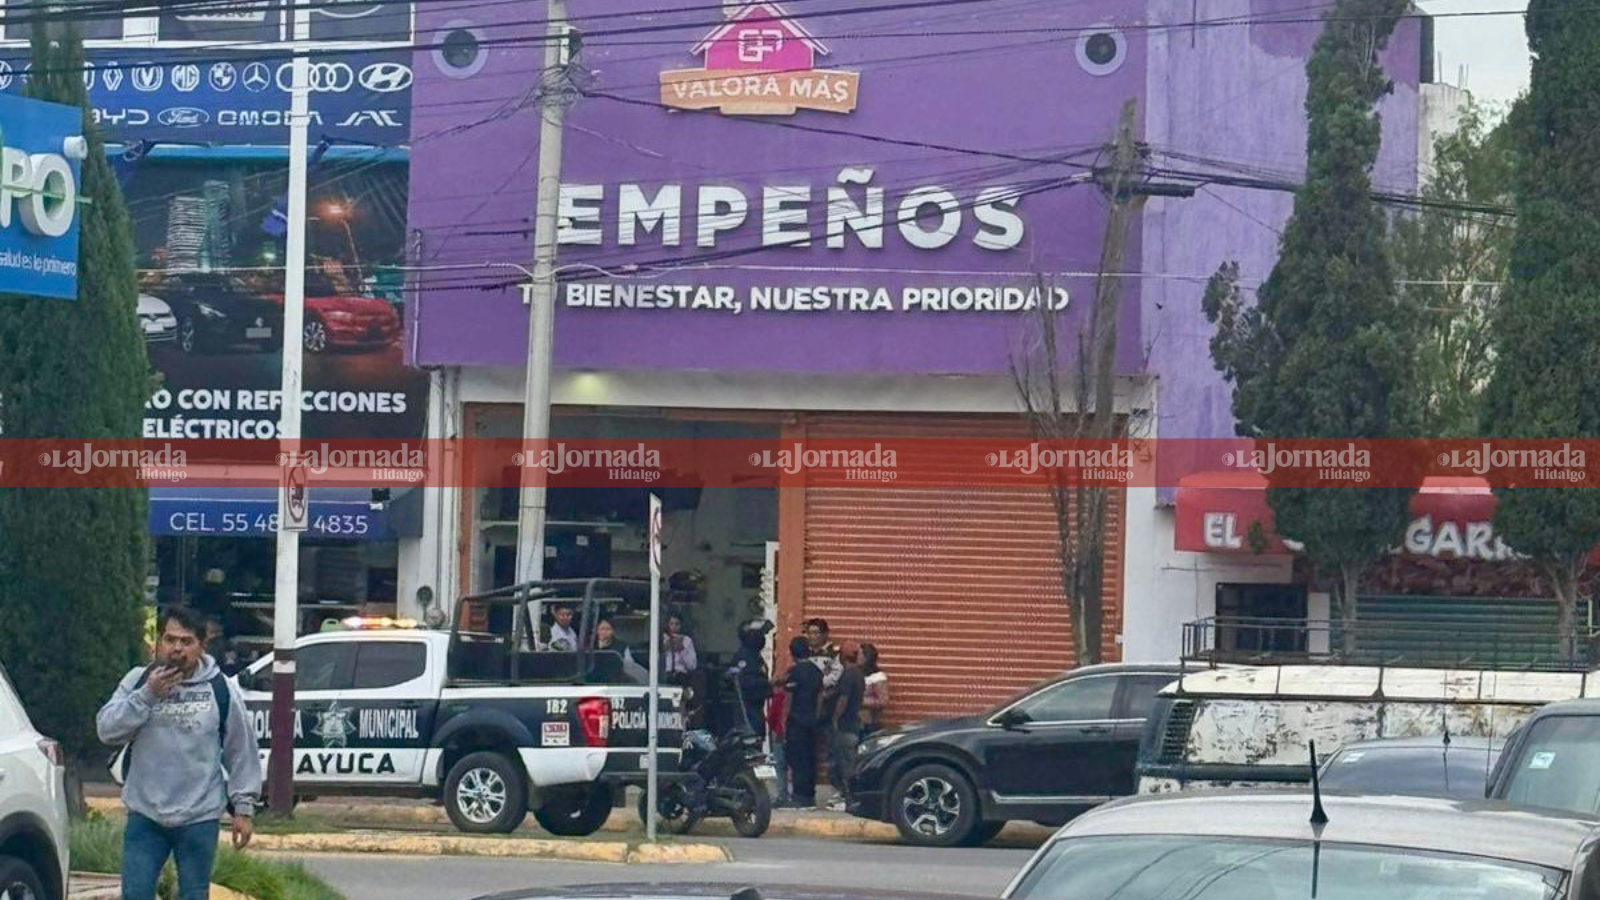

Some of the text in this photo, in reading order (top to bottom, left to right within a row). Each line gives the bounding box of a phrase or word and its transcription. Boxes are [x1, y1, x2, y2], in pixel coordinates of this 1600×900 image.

[673, 75, 849, 102] VALORA MÁS
[558, 167, 1025, 250] EMPEÑOS
[566, 283, 742, 314] BIENESTAR,
[750, 287, 894, 311] NUESTRA
[178, 389, 230, 411] CON
[237, 390, 407, 413] REFCCIONES
[170, 512, 215, 532] CEL.
[222, 513, 248, 532] 55
[313, 515, 369, 534] 4835
[1203, 512, 1243, 549] EL
[359, 709, 419, 739] MUNICIPAL
